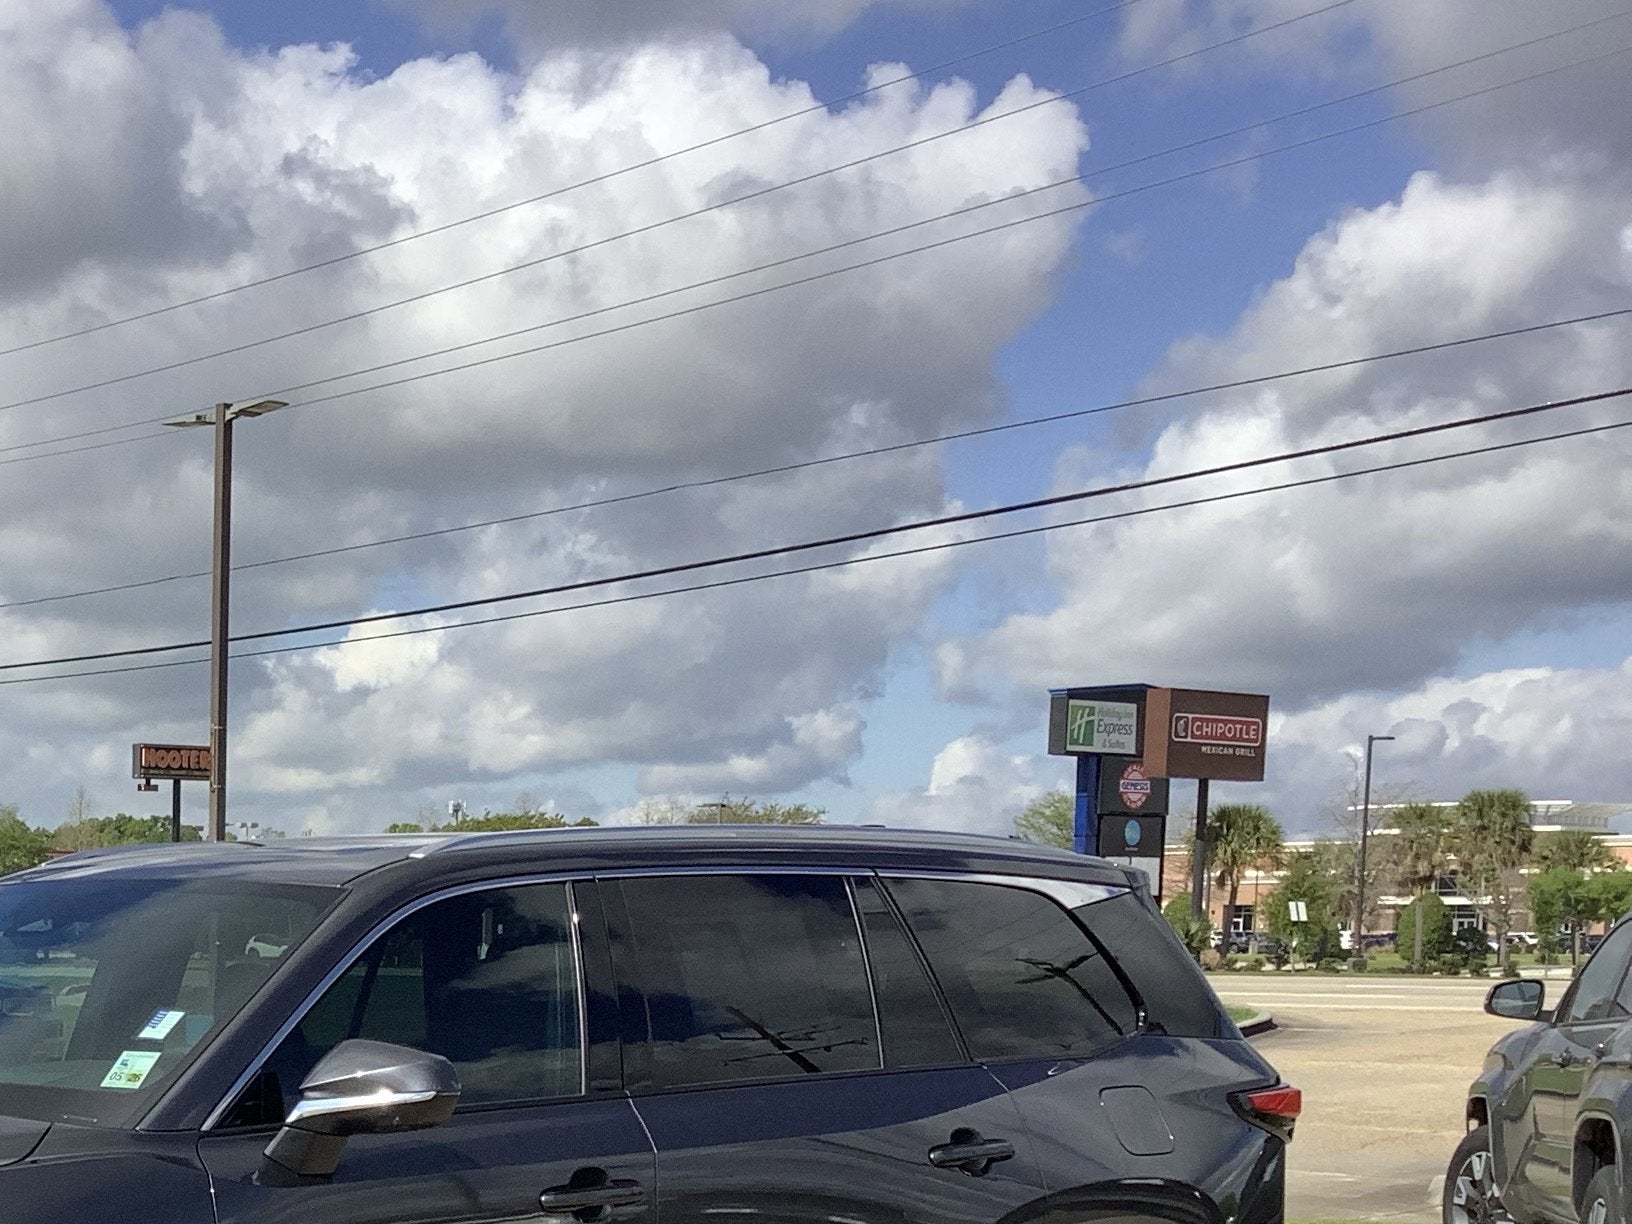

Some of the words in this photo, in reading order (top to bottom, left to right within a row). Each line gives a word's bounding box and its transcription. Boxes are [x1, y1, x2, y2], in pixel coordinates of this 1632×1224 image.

[1097, 718, 1133, 737] Express
[1193, 721, 1258, 739] CHIPOTLE
[141, 748, 212, 768] HOOTER
[1201, 746, 1233, 755] MEXICAN
[1235, 748, 1255, 756] GRILL
[1121, 781, 1149, 790] GENESIS
[110, 1072, 123, 1080] 05
